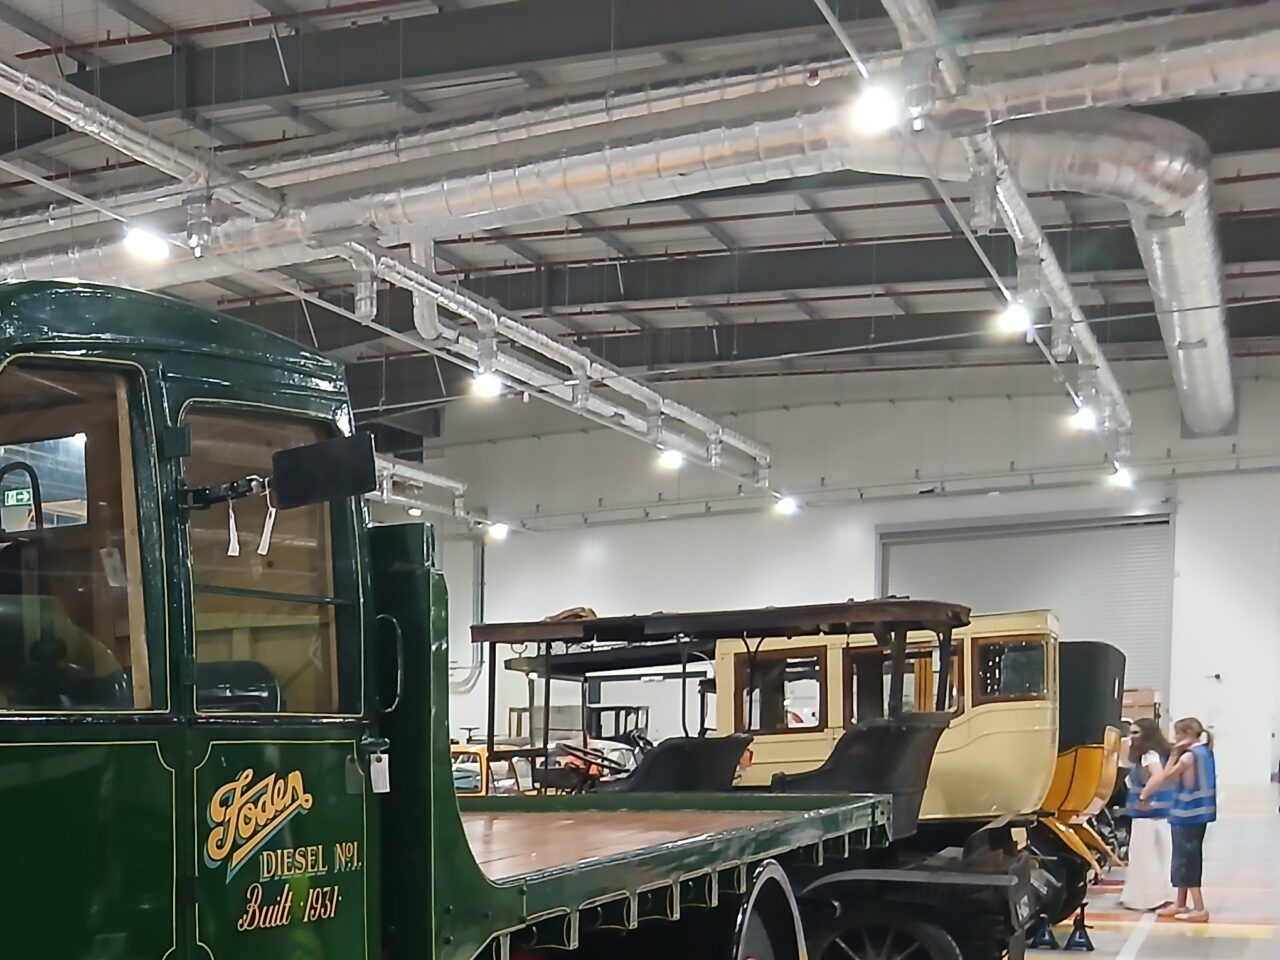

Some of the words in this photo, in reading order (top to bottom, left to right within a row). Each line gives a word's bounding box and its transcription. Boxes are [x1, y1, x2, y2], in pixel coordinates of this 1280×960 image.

[205, 767, 314, 872] Foden
[260, 843, 328, 881] DIESEL
[236, 882, 294, 932] Built
